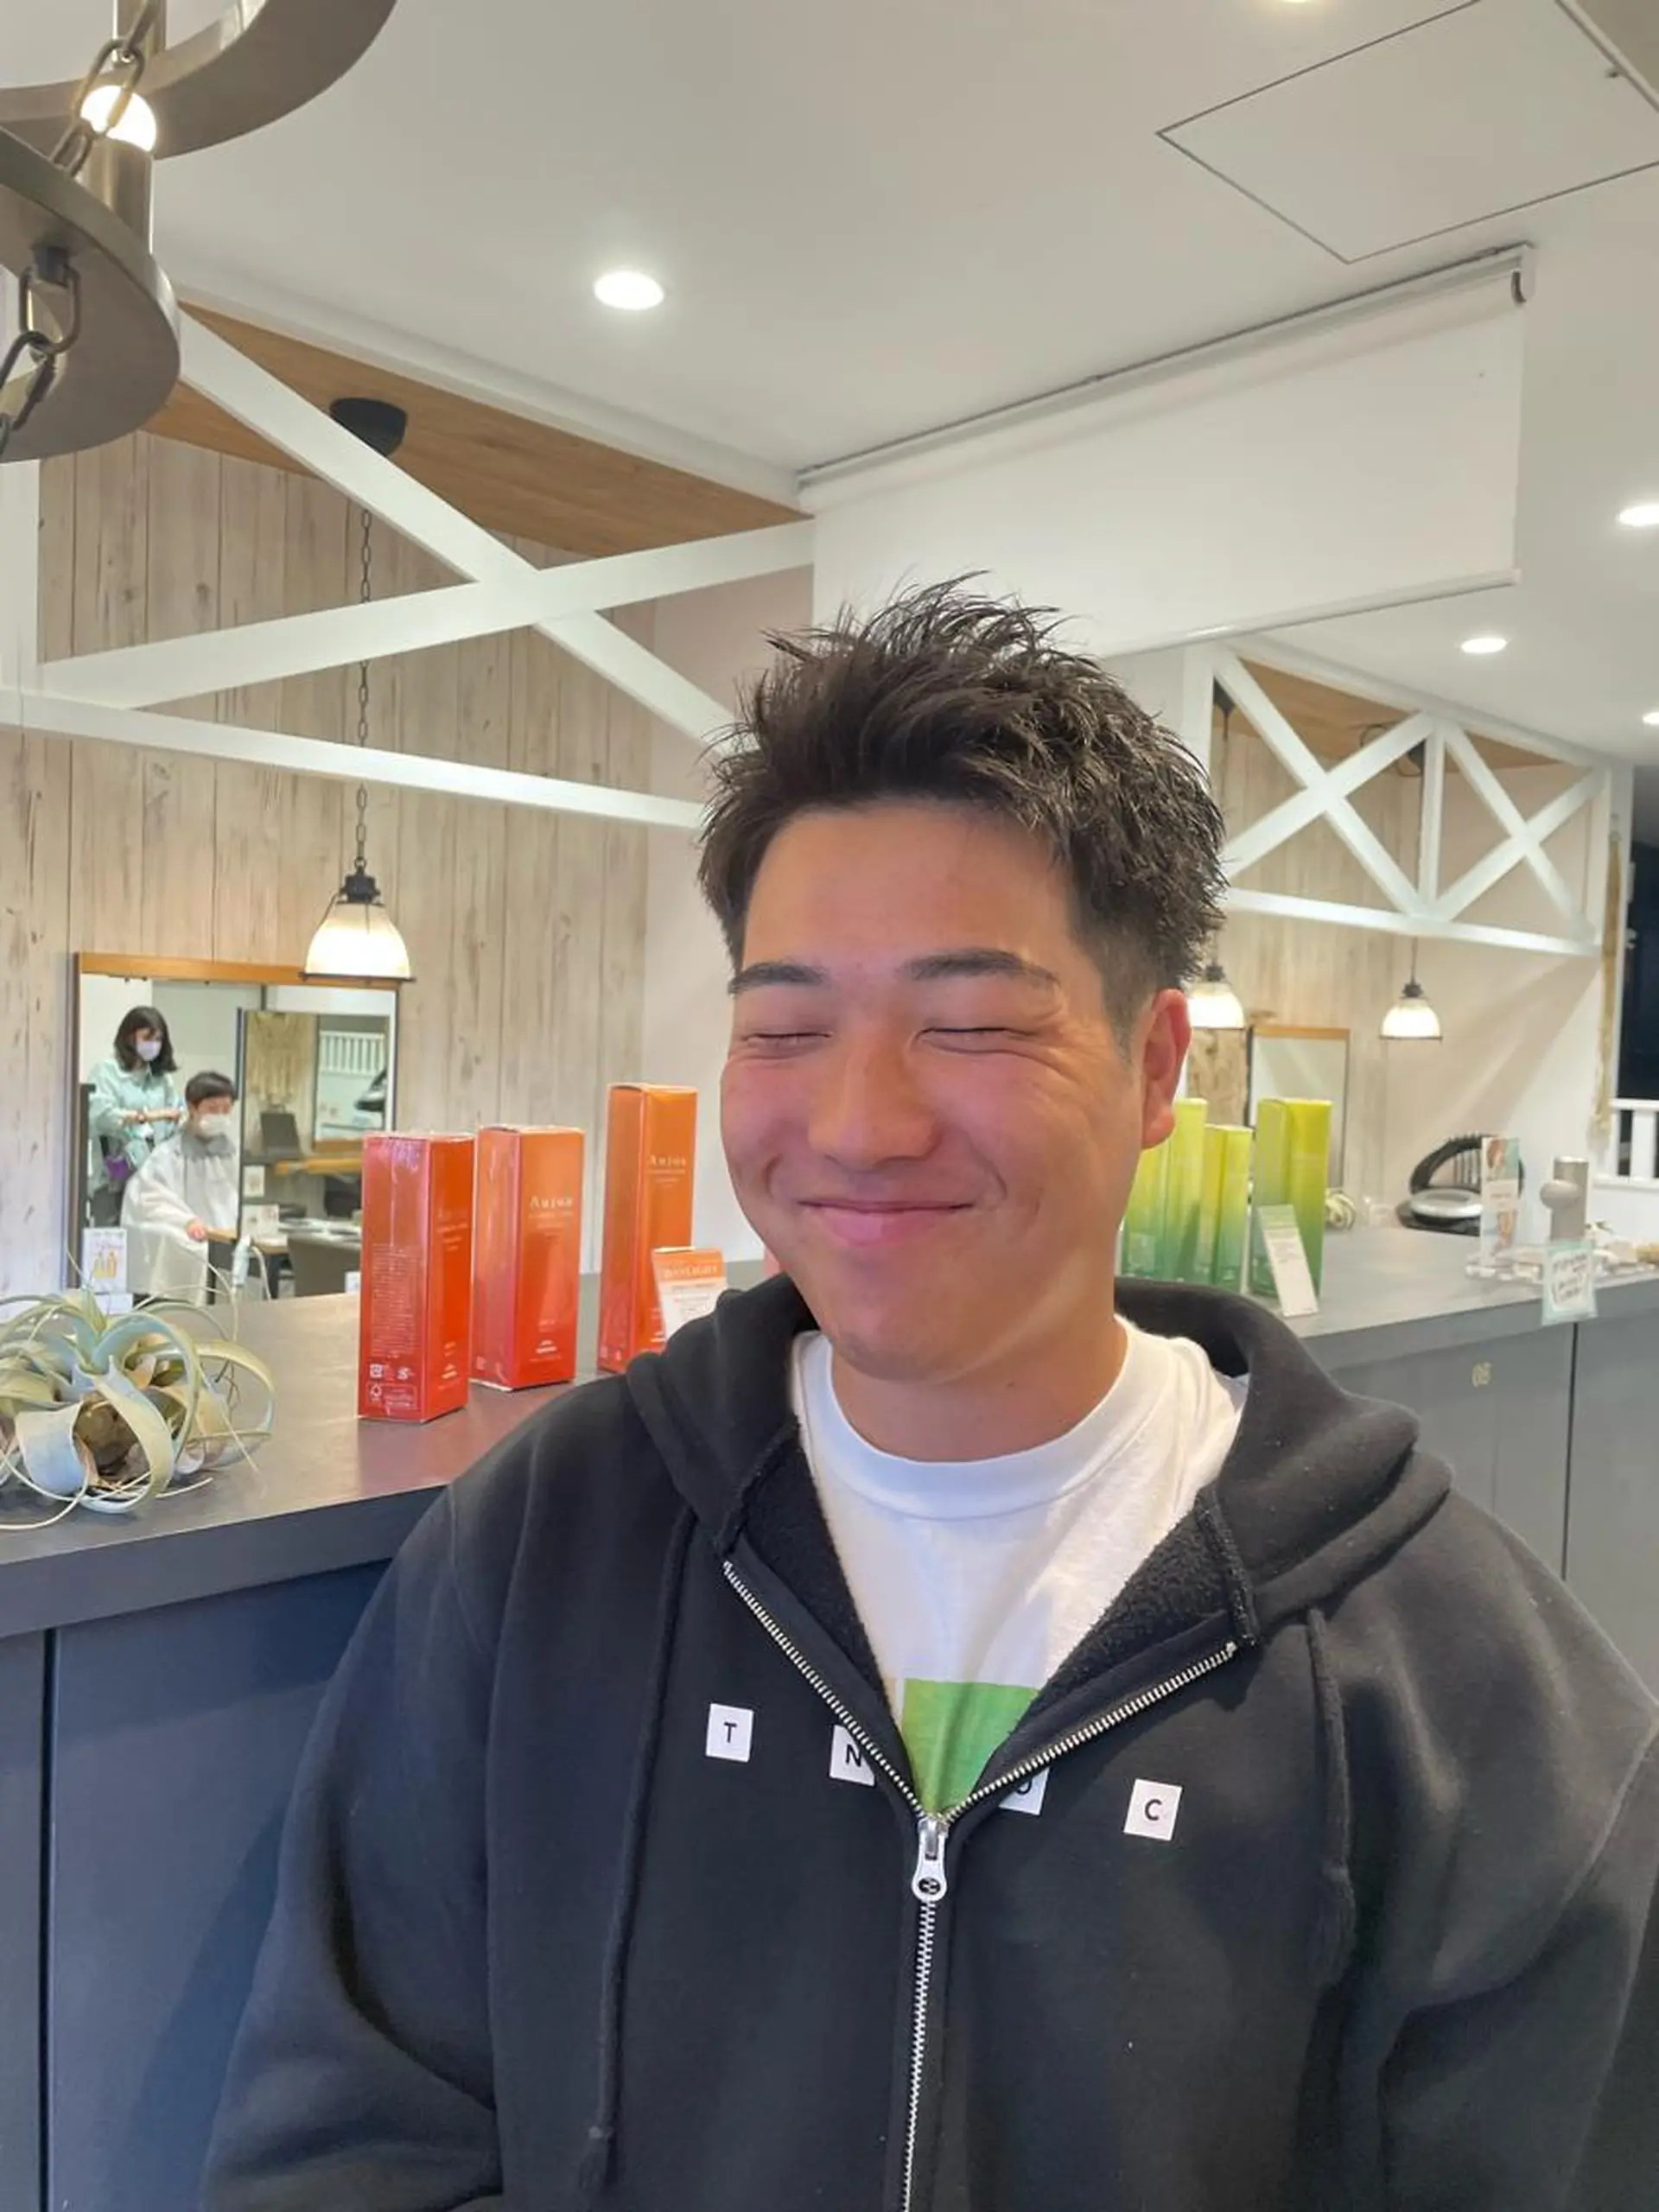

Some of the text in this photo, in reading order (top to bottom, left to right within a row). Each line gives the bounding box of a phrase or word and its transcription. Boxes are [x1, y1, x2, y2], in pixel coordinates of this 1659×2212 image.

[723, 1721, 1163, 1821] T N C
